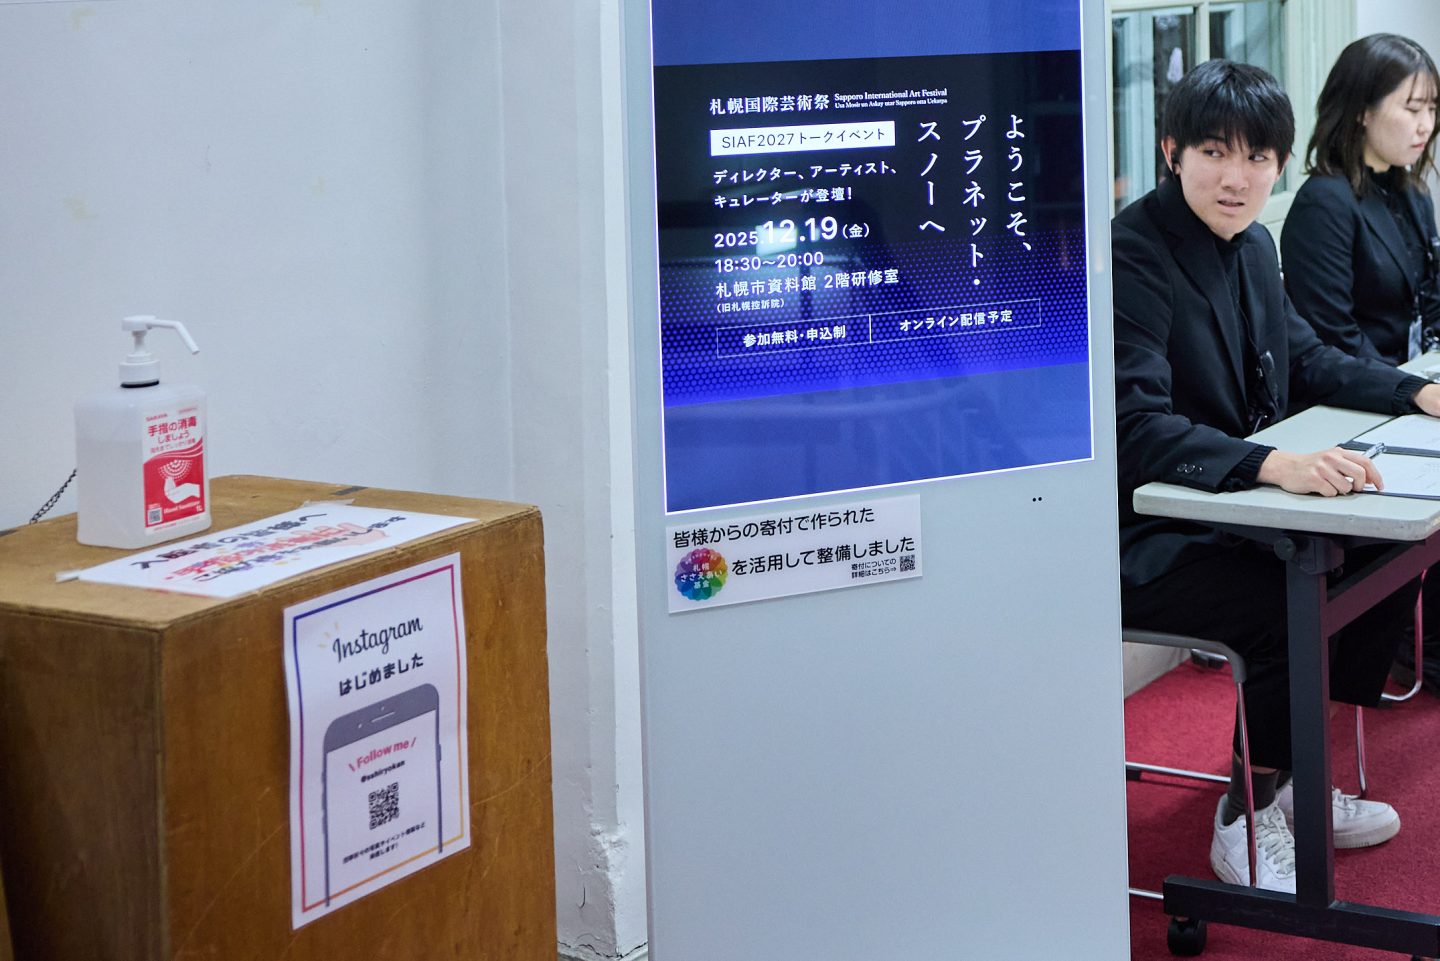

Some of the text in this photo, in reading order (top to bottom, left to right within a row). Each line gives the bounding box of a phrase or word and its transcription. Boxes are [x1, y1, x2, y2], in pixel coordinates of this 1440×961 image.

[709, 93, 830, 115] 札幌国際芸術祭
[834, 88, 948, 103] Sapporo International Art Festival
[918, 121, 945, 232] スノーへ
[1006, 114, 1031, 251] ようこそ、
[716, 268, 899, 298] 札幌市資料館 2階研修室
[900, 309, 1013, 331] オンライン配信予定
[158, 430, 190, 443] しましょう
[673, 507, 875, 548] 皆様からの寄付で作られた
[732, 536, 915, 576] を活用して整備しました
[851, 558, 896, 570] 寄付についての
[333, 617, 423, 663] Instagram
[339, 652, 423, 696] はじめました
[356, 740, 409, 769] Follow me
